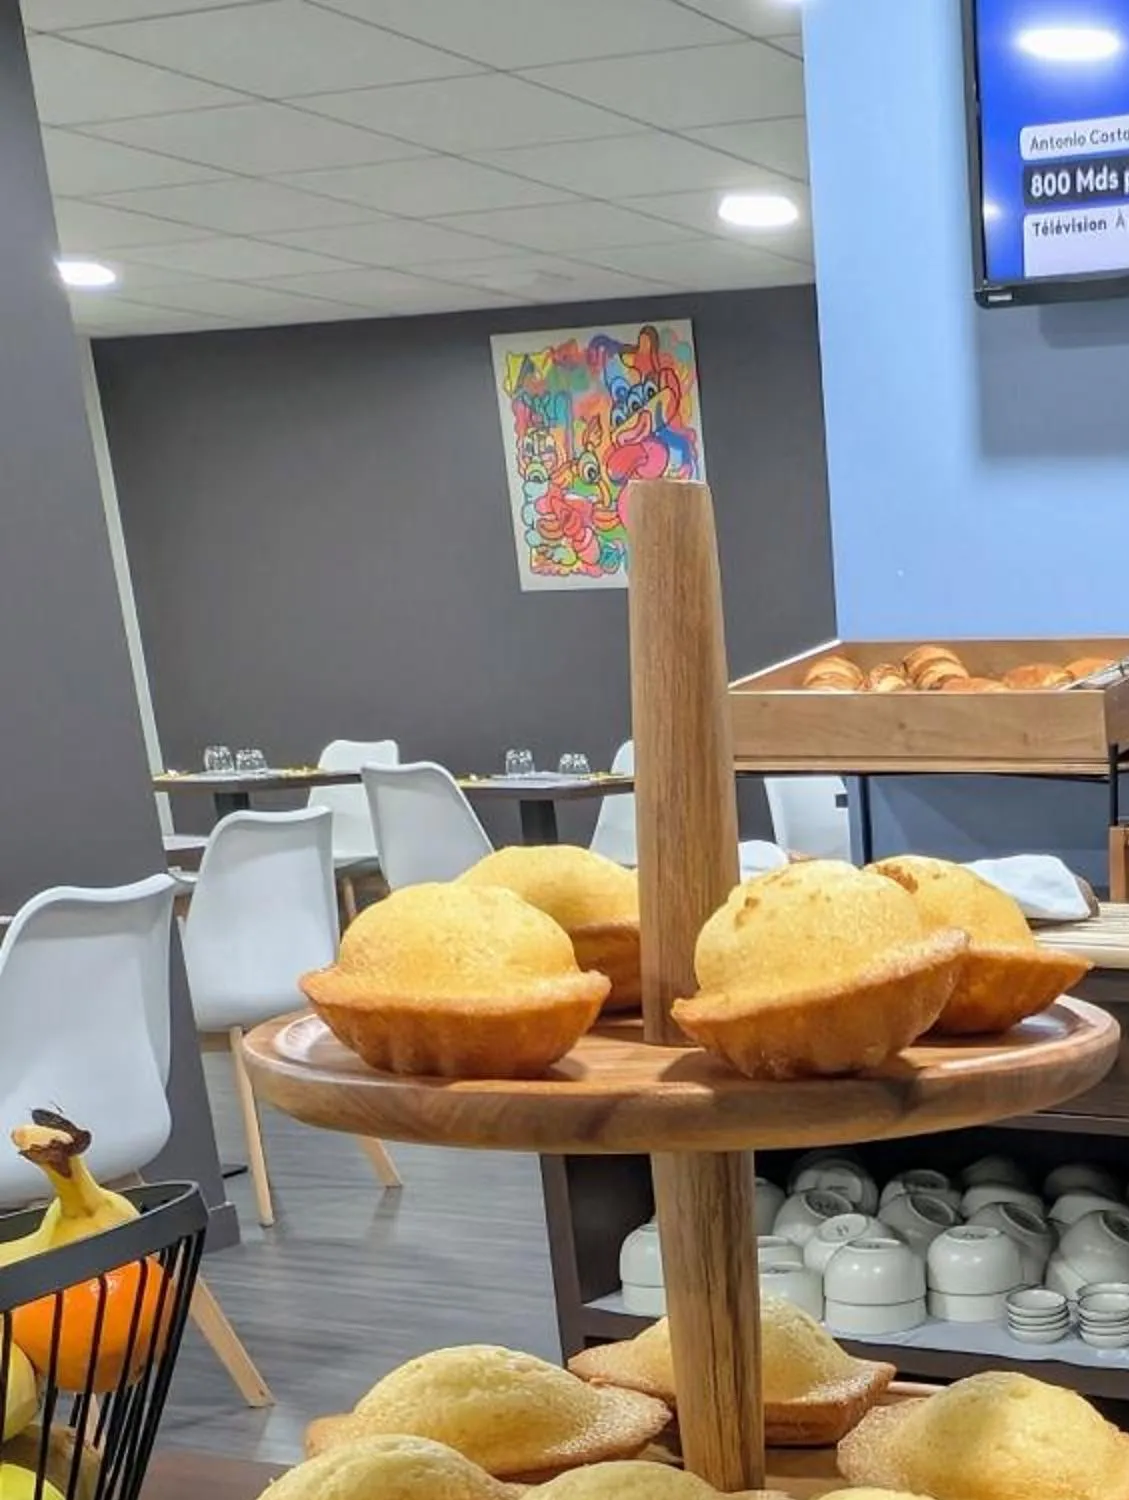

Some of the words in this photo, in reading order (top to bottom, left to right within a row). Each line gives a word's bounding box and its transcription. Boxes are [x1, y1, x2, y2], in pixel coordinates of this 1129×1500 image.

[1030, 131, 1087, 152] Antonio
[1030, 170, 1071, 197] 800
[1075, 164, 1119, 193] Mds
[1032, 216, 1107, 237] Télévision
[1115, 207, 1126, 228] À
